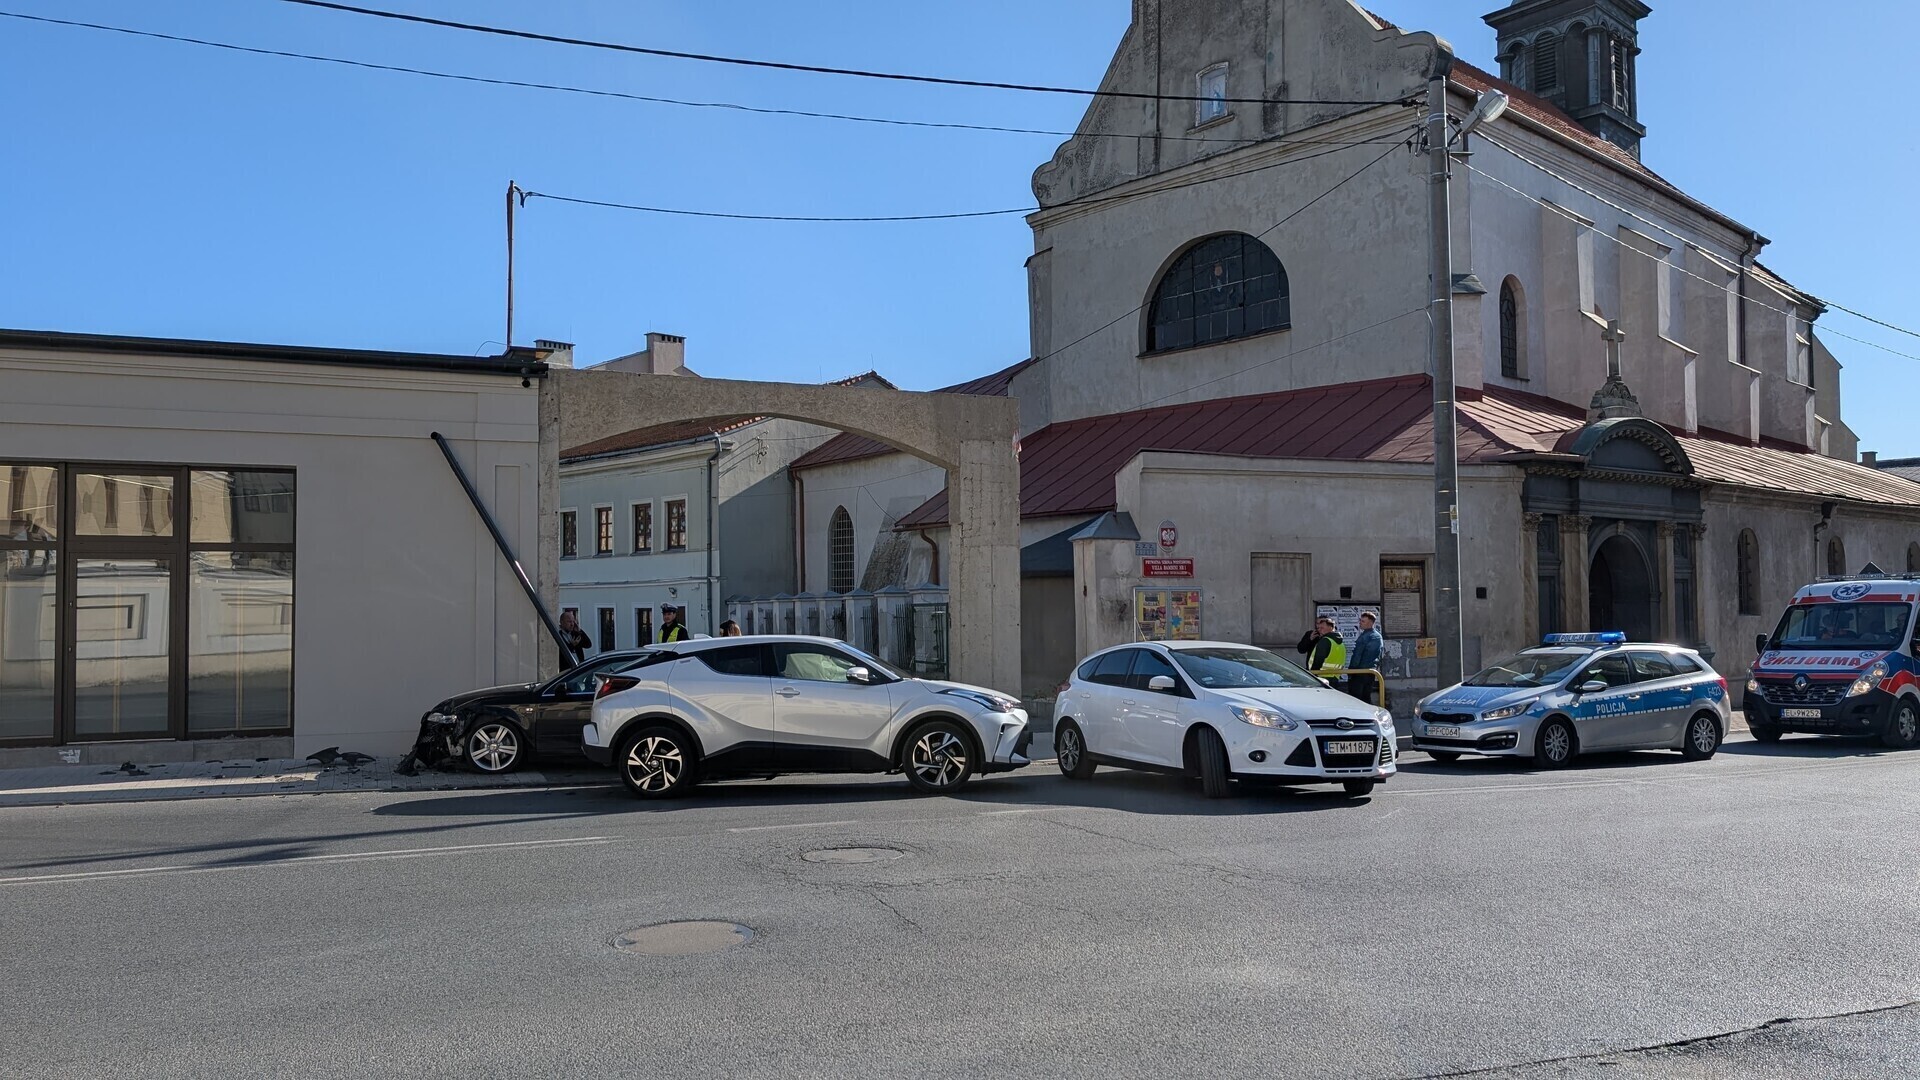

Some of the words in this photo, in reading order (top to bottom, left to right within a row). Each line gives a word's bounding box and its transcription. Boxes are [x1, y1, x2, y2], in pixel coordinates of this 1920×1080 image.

[1596, 701, 1627, 714] POLICJA
[1329, 742, 1346, 753] ETM
[1349, 742, 1373, 753] 11875
